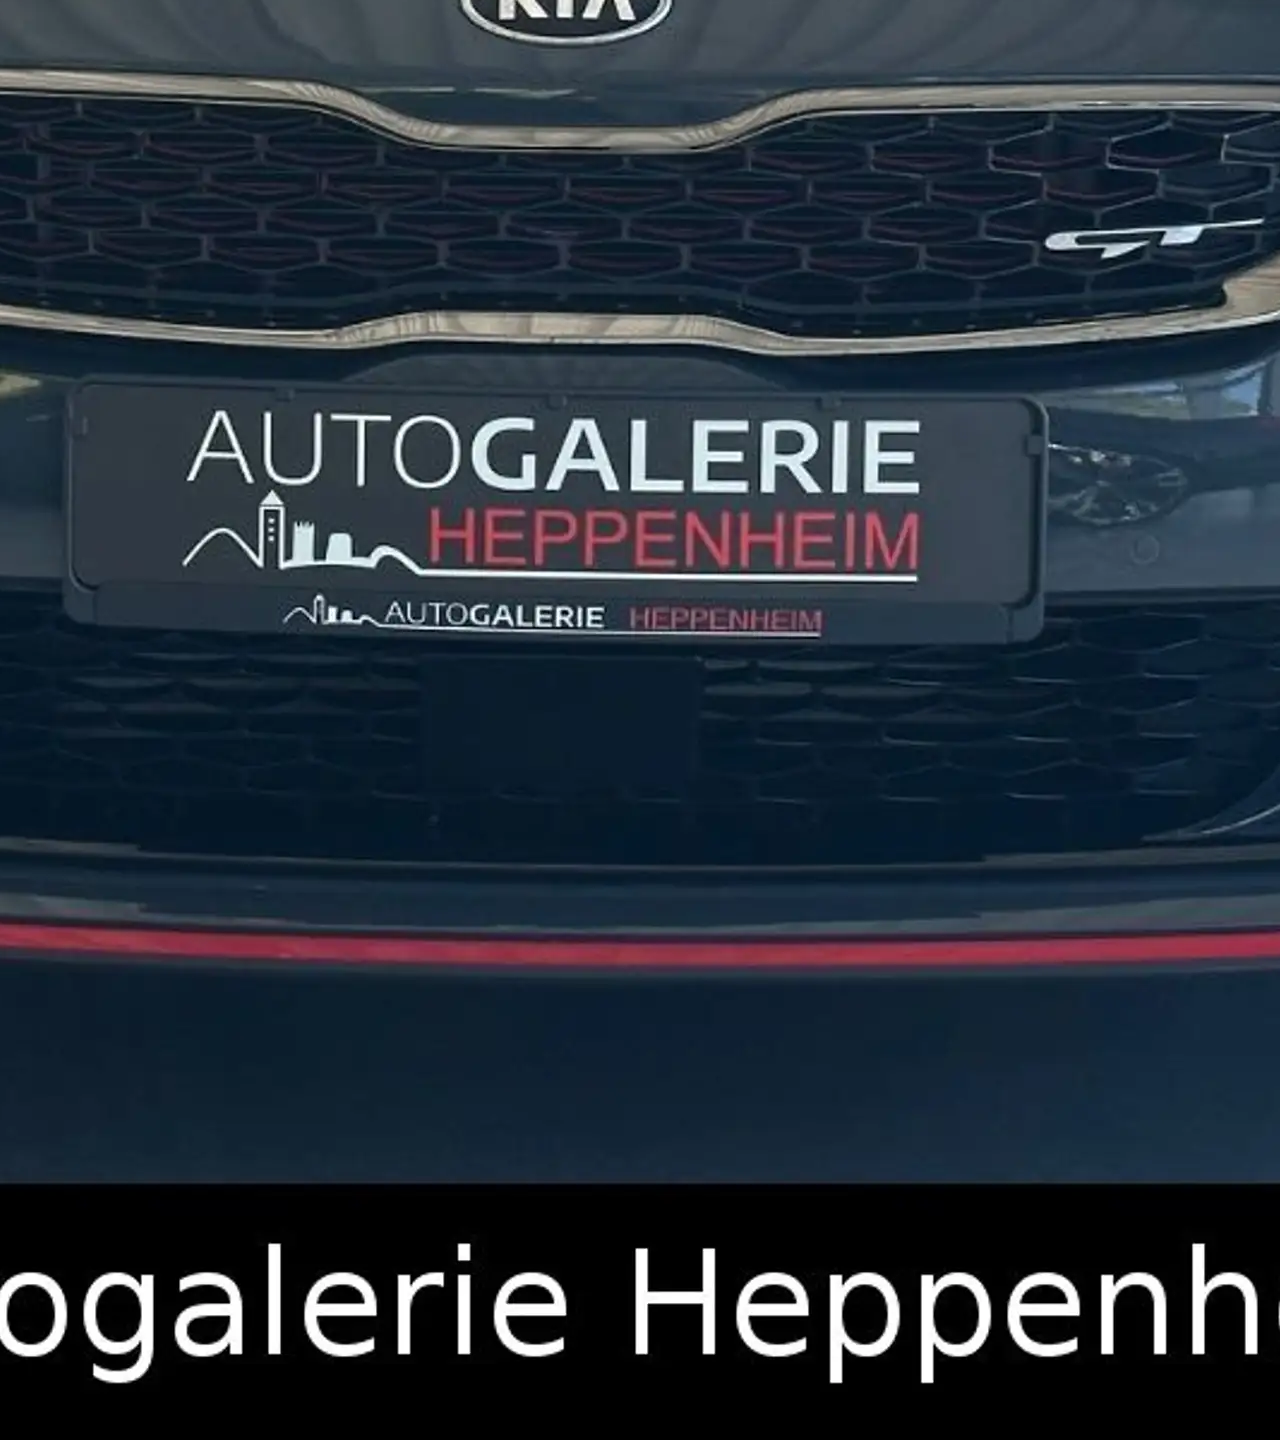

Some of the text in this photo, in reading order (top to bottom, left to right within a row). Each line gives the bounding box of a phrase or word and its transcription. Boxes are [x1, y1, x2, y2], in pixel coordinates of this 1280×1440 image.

[1045, 217, 1264, 259] GT
[186, 410, 920, 494] AUTOGALERIE
[429, 506, 920, 569] HEPPENHEIM
[384, 601, 822, 632] AUTOGALERIE HEPPENHEIM
